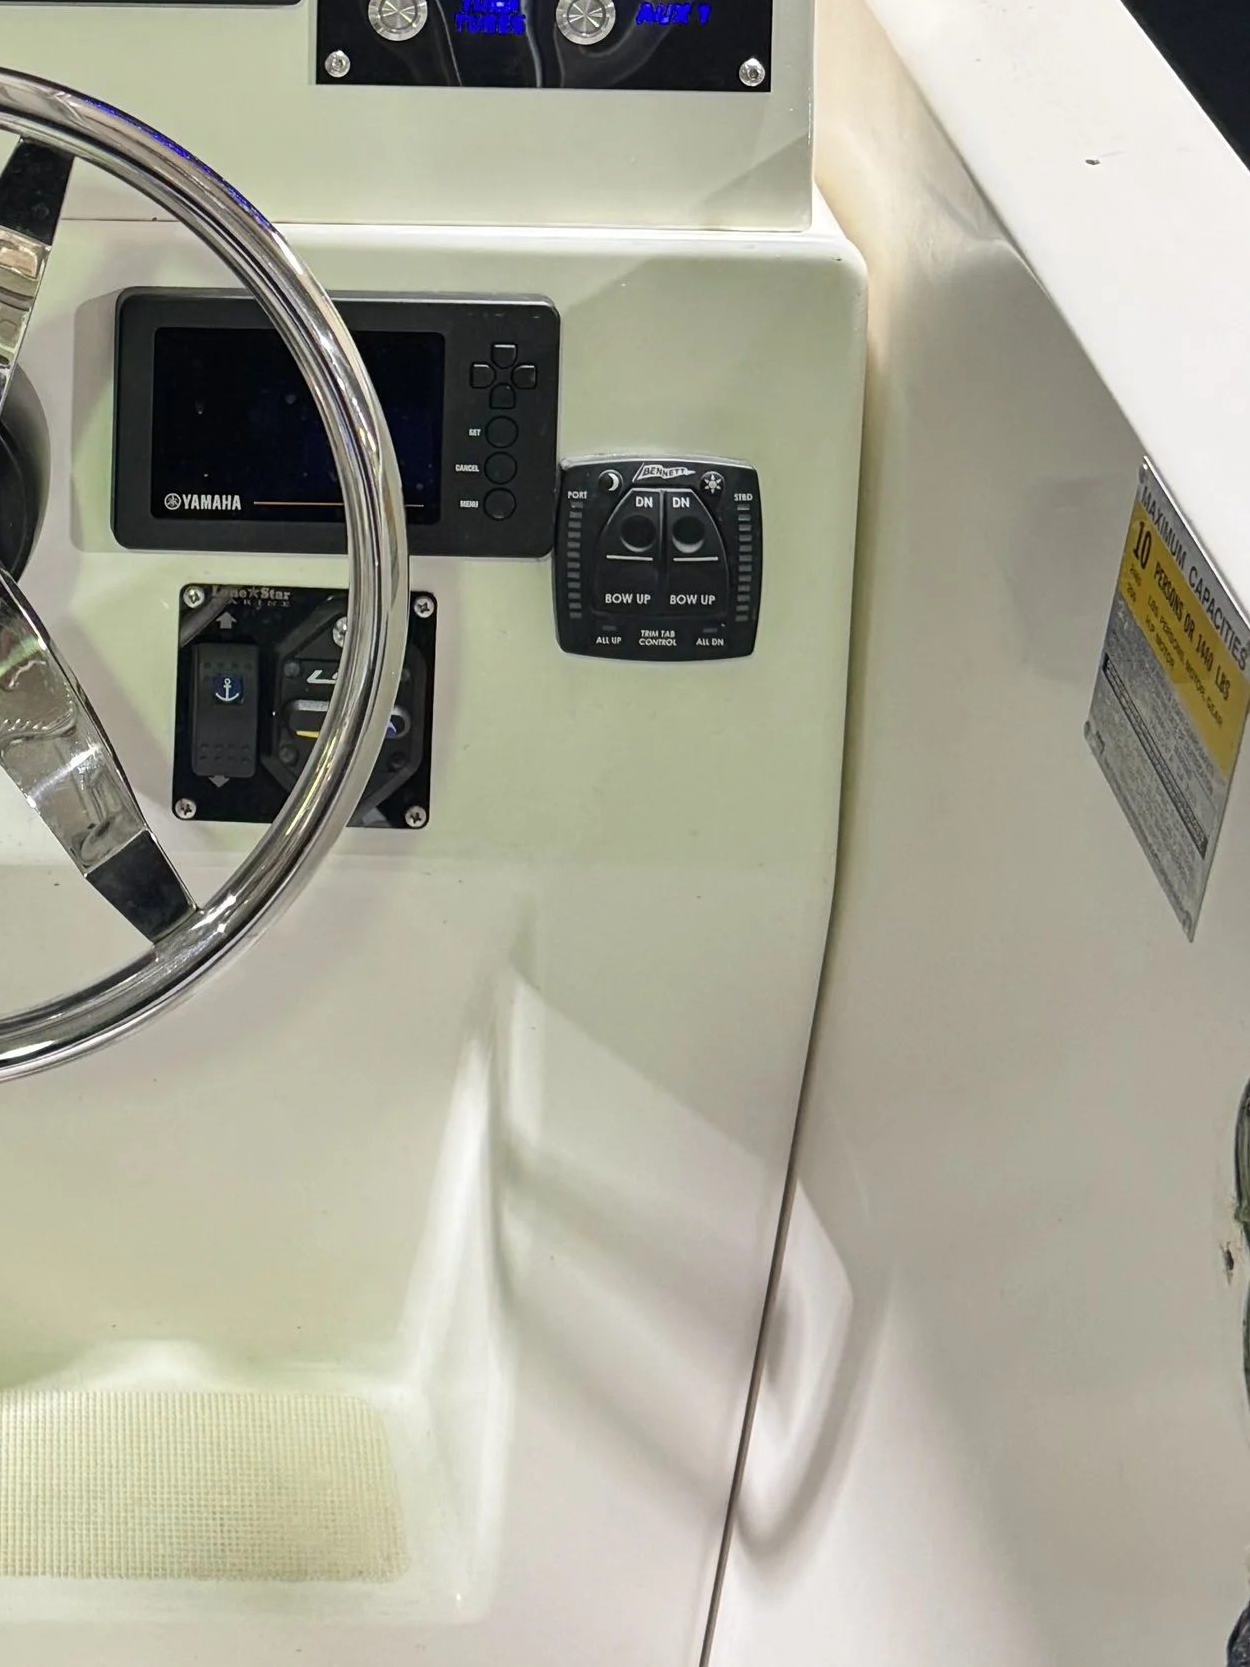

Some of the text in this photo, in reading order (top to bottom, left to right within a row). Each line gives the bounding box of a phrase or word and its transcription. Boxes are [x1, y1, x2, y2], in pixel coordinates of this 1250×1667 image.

[636, 2, 691, 24] AUX
[455, 463, 480, 472] CANCEL
[642, 465, 686, 478] BENNETT
[567, 491, 588, 500] PORT
[733, 493, 754, 502] STBD
[182, 493, 241, 511] YAMAHA
[635, 496, 653, 508] DN
[672, 497, 690, 508] DN
[1133, 520, 1153, 571] 10
[1153, 560, 1184, 622] PERSONS
[1183, 613, 1196, 643] OR
[1141, 485, 1188, 571] MAXIMUM
[1188, 565, 1249, 672] CAPACITIES
[260, 586, 291, 600] Star
[605, 593, 651, 604] BOW UP
[669, 595, 716, 605] BOW UP
[640, 629, 675, 638] TRIM TAB
[596, 636, 622, 645] ALL UP
[638, 638, 677, 647] CONTROL
[696, 638, 725, 647] ALL DN
